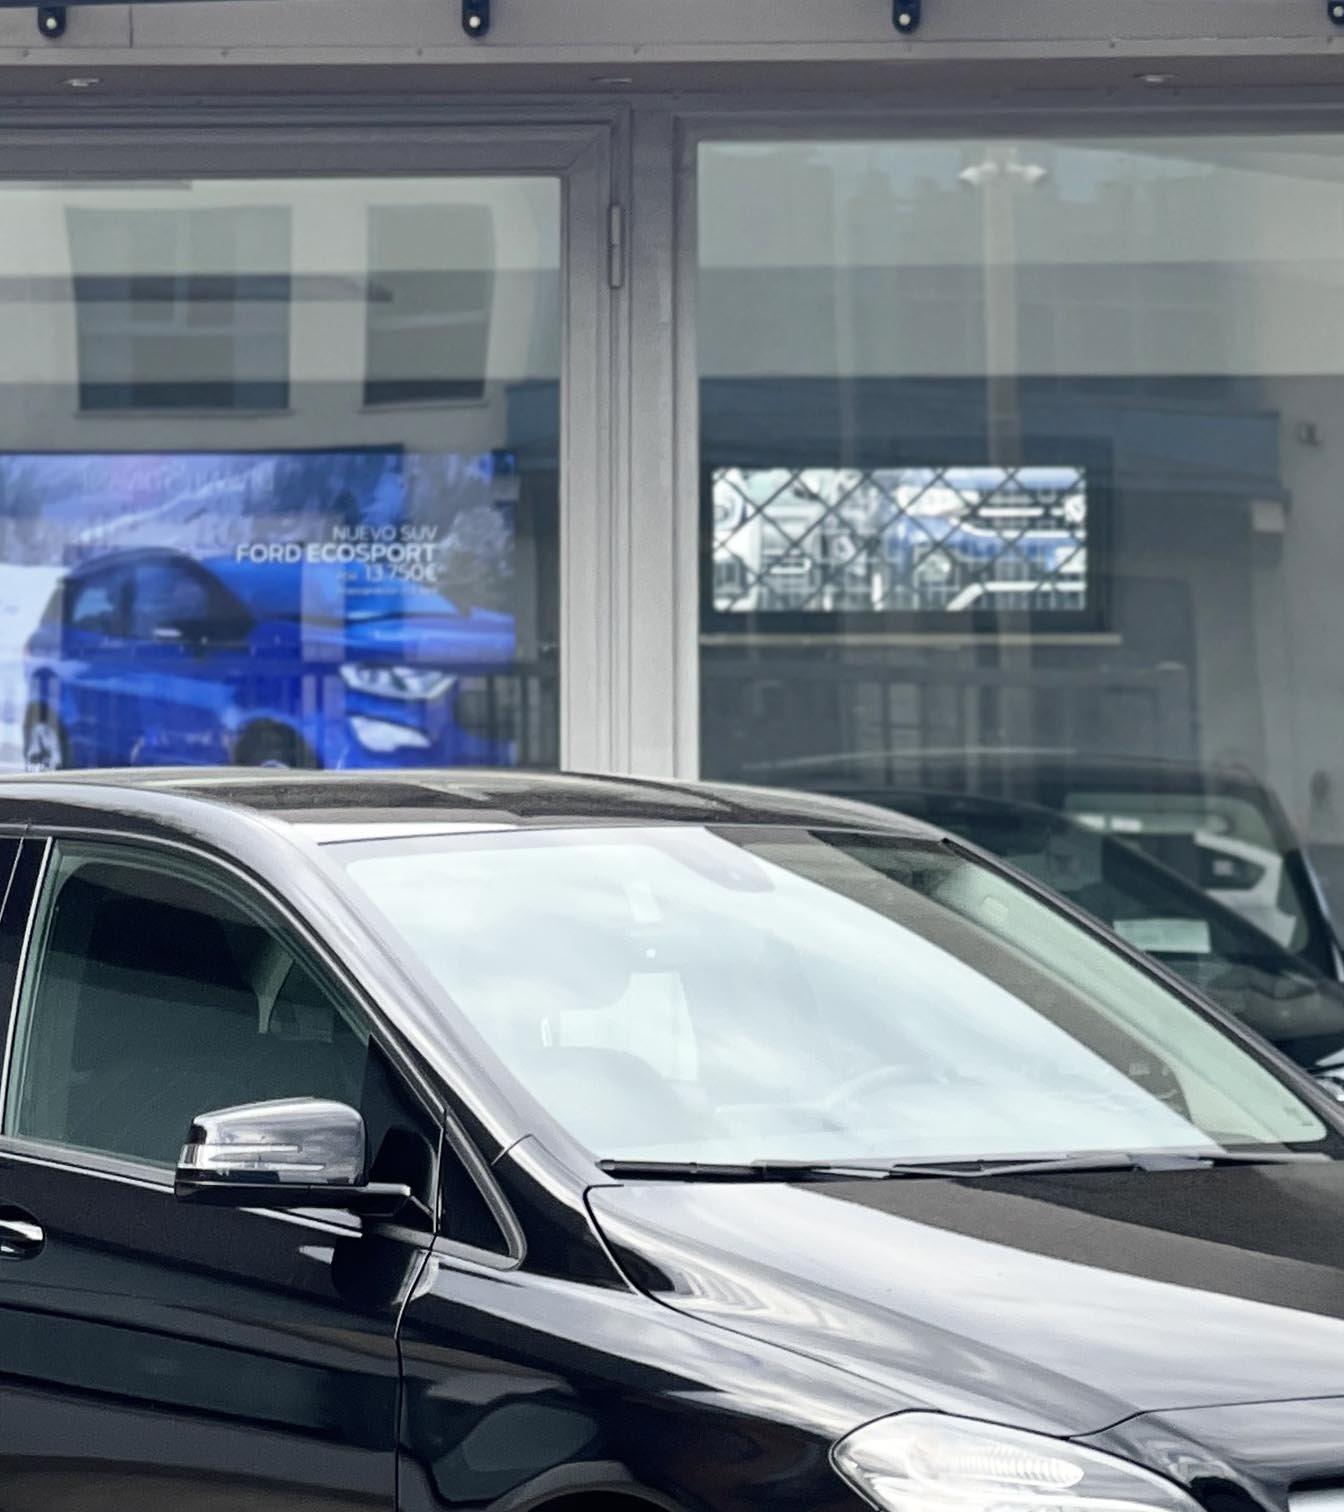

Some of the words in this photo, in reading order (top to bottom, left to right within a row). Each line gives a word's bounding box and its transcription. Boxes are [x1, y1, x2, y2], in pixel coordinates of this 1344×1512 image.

[332, 525, 396, 541] NUEVO
[401, 525, 438, 541] SUV
[235, 543, 301, 563] FORD
[307, 543, 438, 563] ECOSPORT
